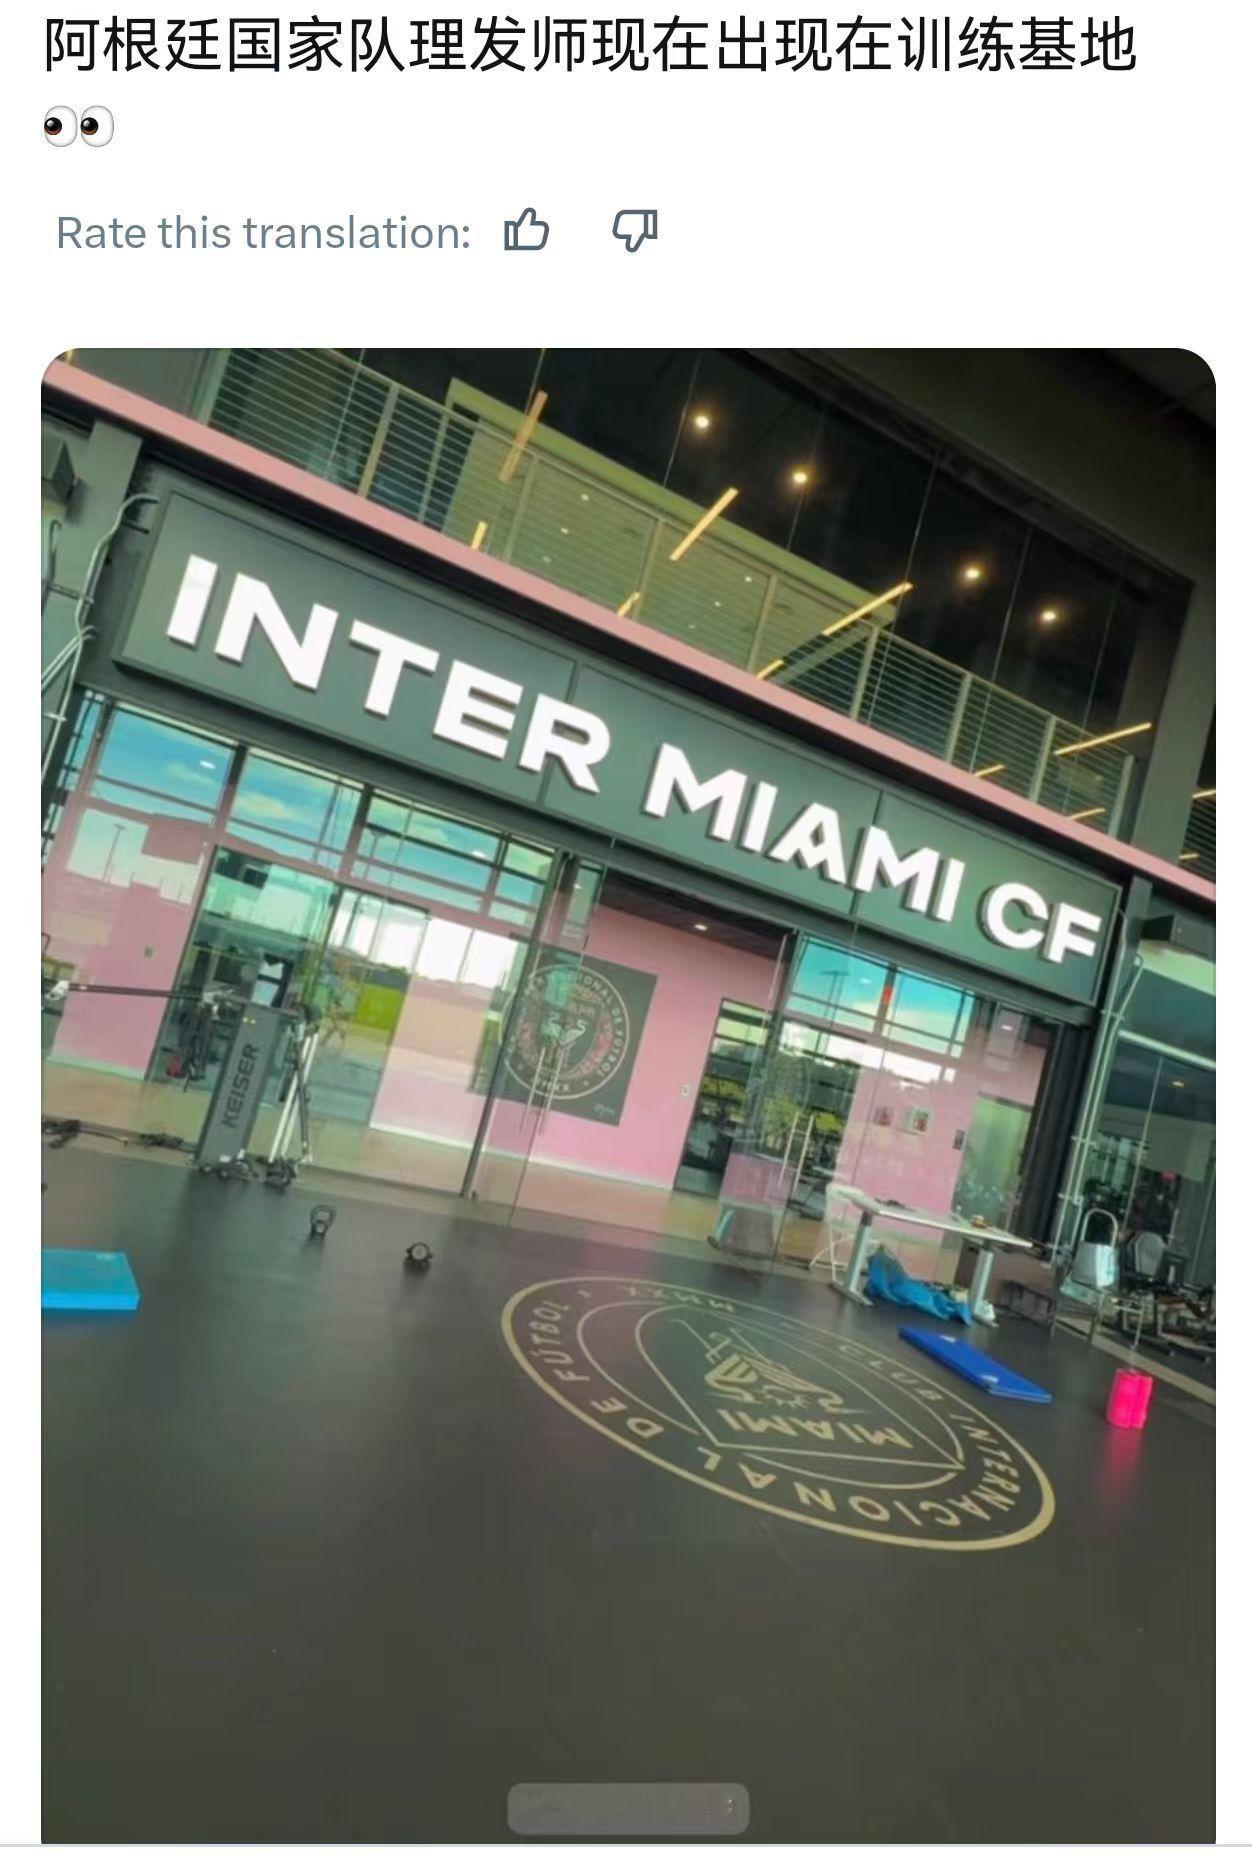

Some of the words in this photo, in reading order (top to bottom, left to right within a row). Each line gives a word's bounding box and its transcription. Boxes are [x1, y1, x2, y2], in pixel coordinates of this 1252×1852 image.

[166, 553, 612, 794] INTER
[641, 742, 966, 923] MIAMI
[981, 881, 1102, 964] CF
[221, 1043, 260, 1129] KEISER
[590, 1397, 664, 1440] DE
[715, 1407, 915, 1450] MIAMI
[696, 1412, 1022, 1527] INTERNACIONAL
